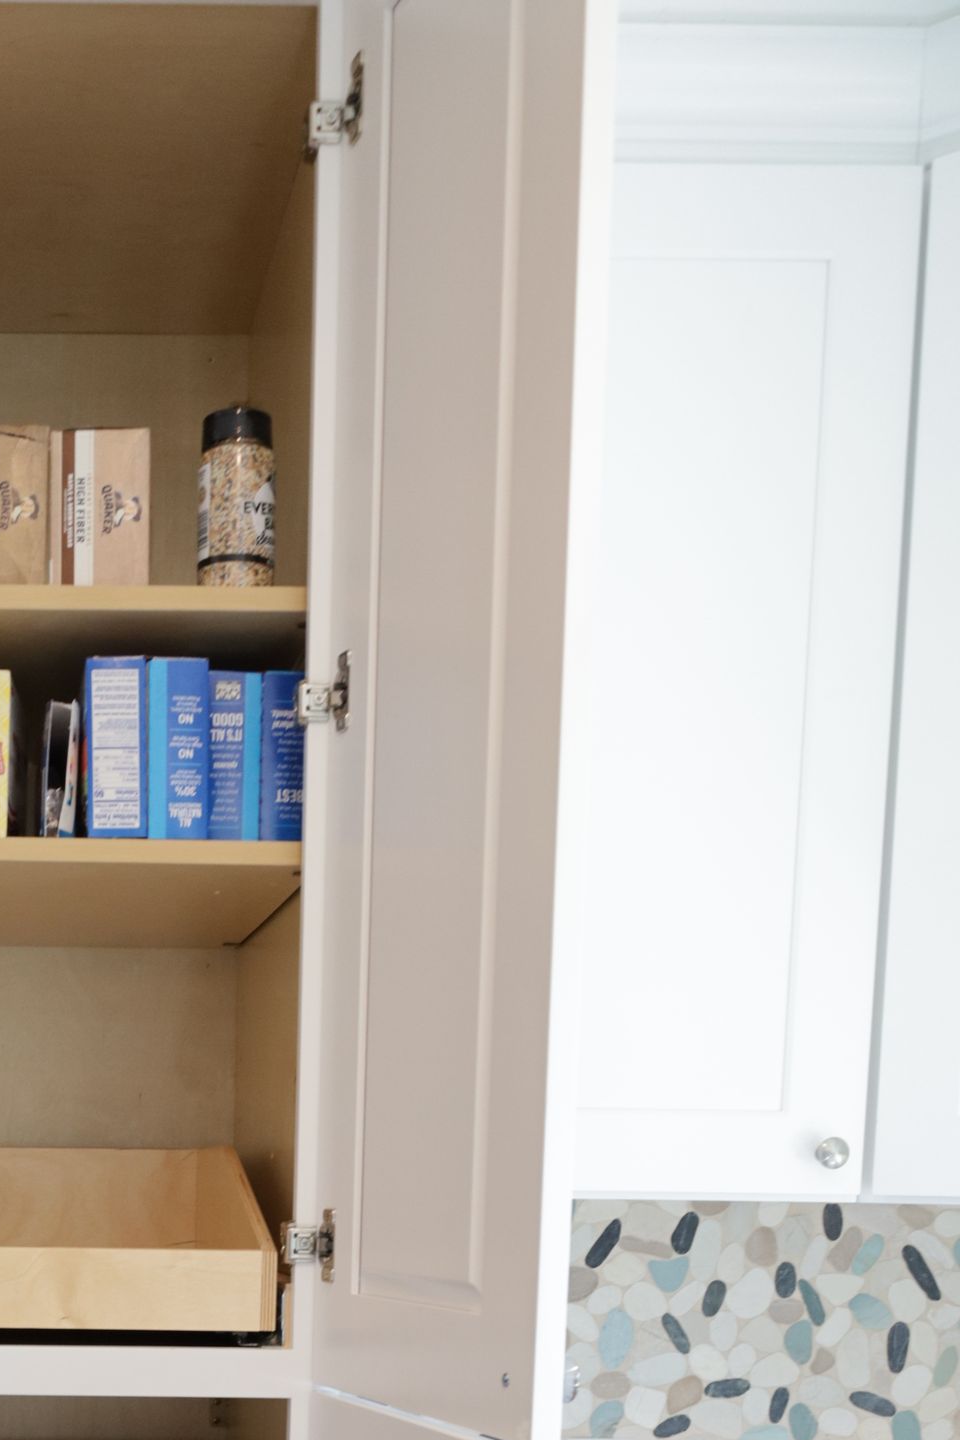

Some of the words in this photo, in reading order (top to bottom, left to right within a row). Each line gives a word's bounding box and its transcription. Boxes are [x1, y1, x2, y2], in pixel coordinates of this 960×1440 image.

[76, 478, 86, 505] HIGH
[101, 485, 115, 535] QUAKER
[76, 509, 85, 543] FIBER
[178, 713, 194, 725] NO
[209, 728, 225, 742] ALL
[226, 728, 243, 742] IT'S
[178, 748, 194, 760] NO
